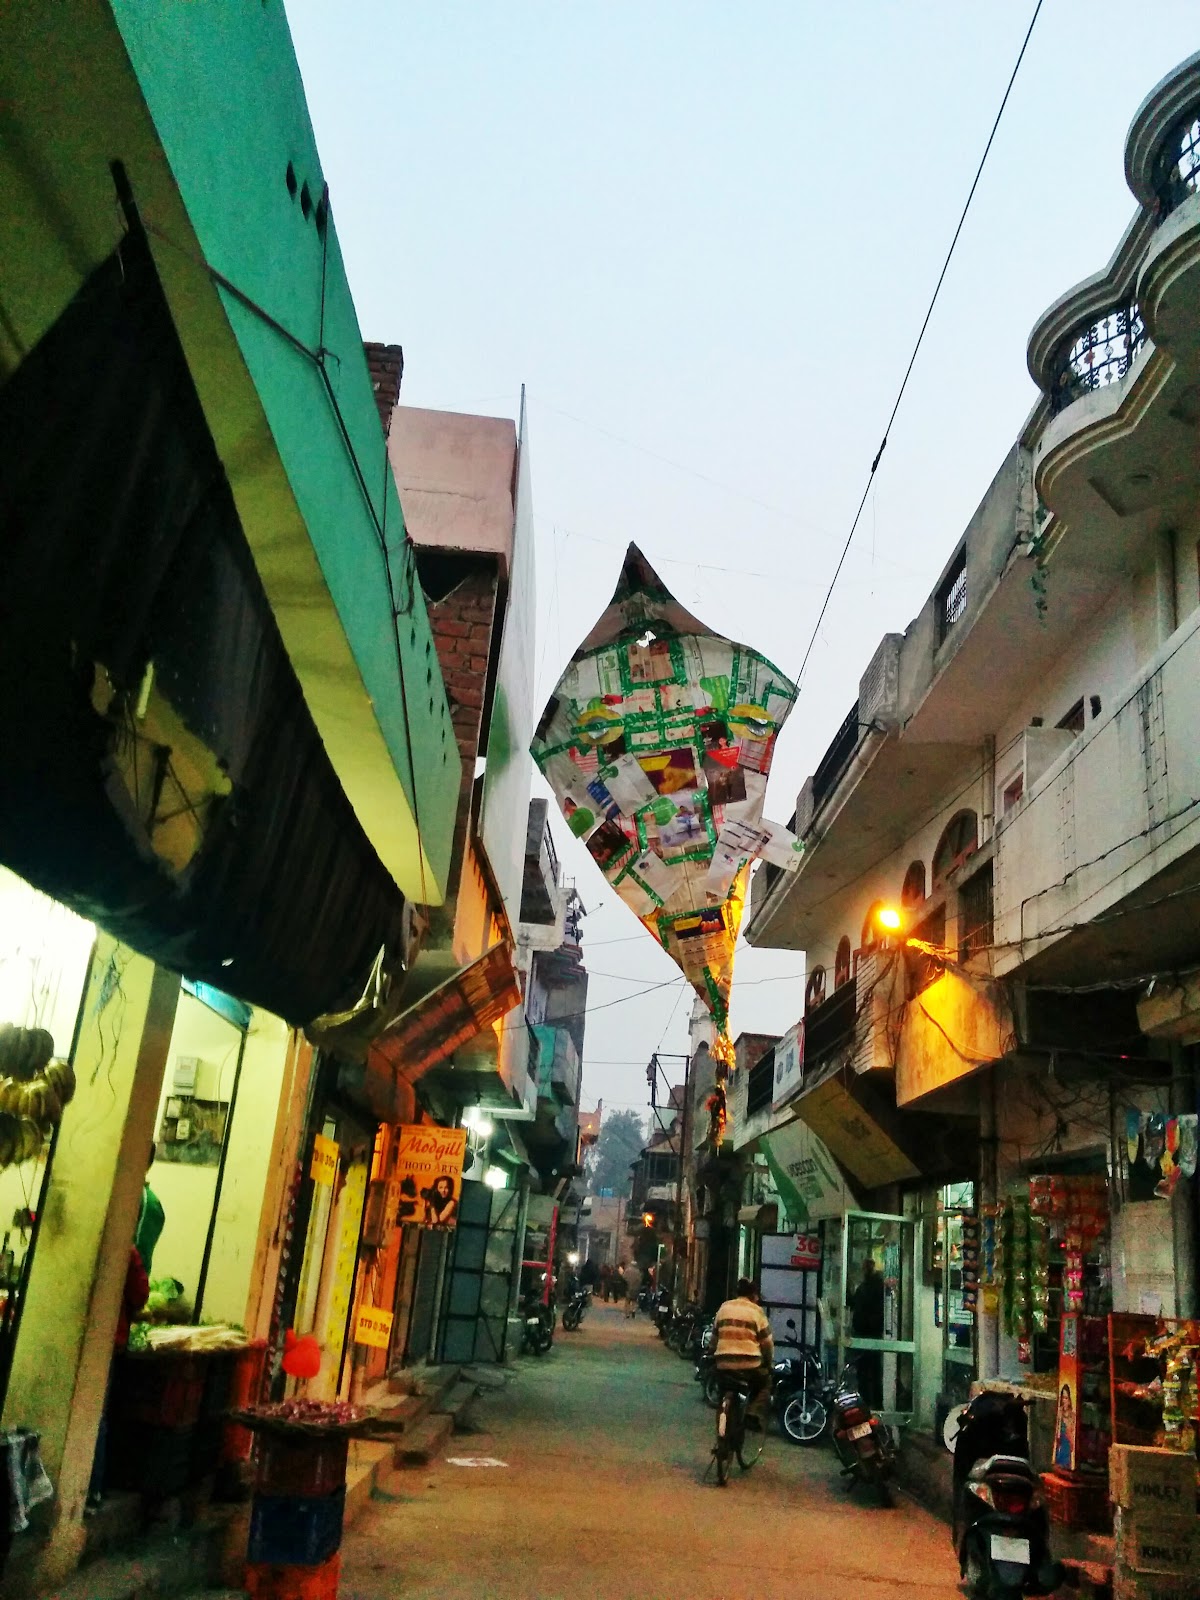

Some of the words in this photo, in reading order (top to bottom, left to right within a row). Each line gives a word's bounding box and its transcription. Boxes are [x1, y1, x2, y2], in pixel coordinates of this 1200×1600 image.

[400, 1136, 462, 1160] Modgill
[399, 1159, 431, 1171] PHOTO
[435, 1161, 459, 1174] ARTS
[796, 1235, 820, 1254] 3G
[360, 1318, 373, 1330] STD
